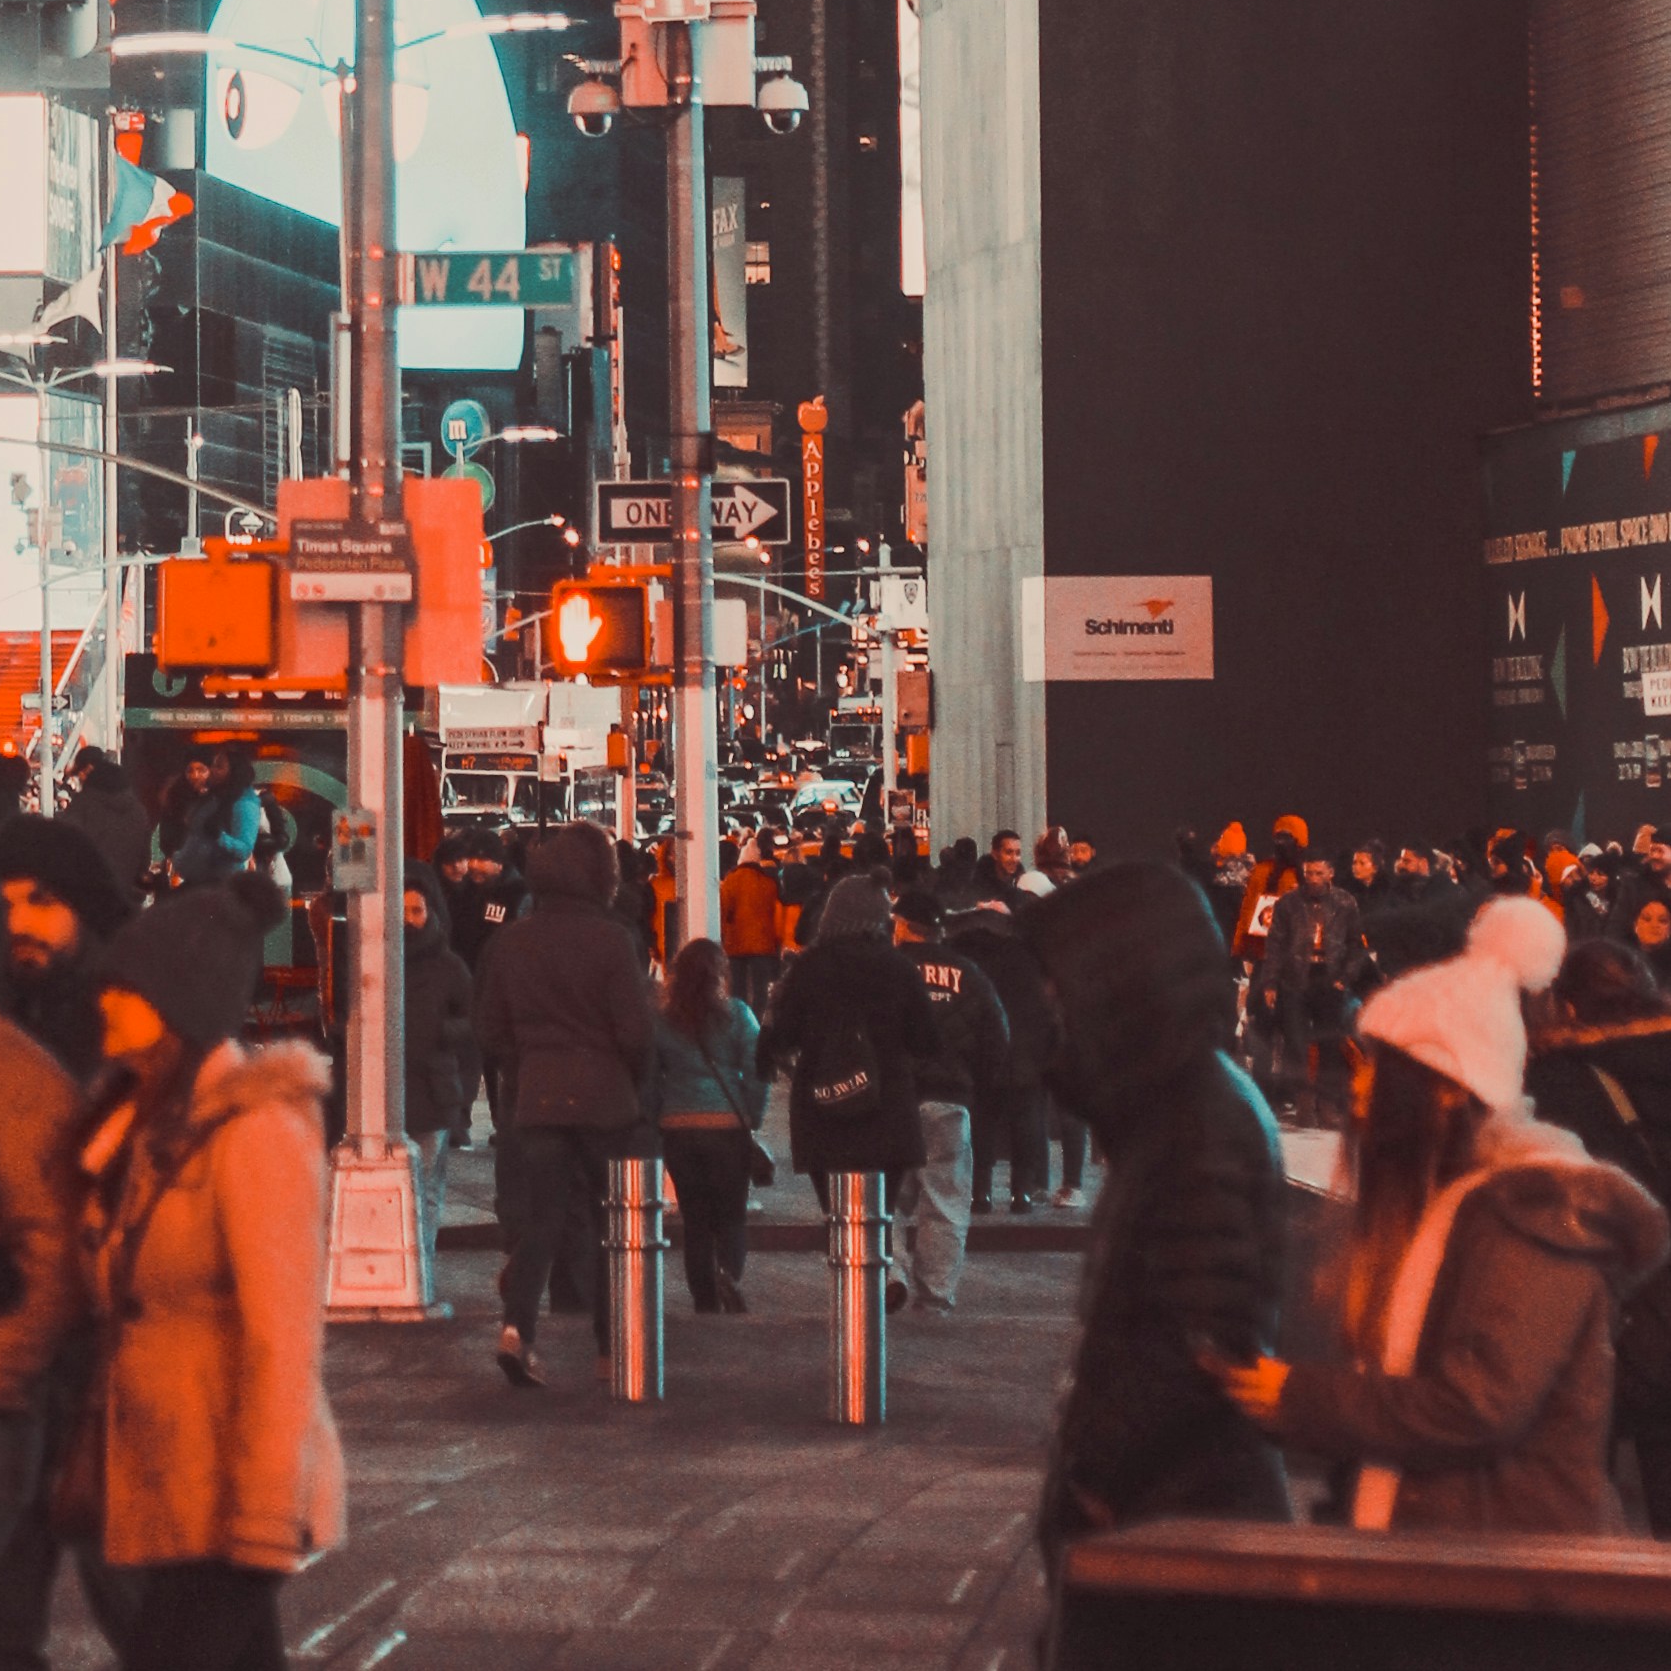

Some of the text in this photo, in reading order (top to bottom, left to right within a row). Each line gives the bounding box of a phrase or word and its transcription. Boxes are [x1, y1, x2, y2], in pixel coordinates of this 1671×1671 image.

[418, 256, 562, 303] W 44 ST
[297, 538, 393, 555] Times Square
[1085, 618, 1175, 636] Schimenti
[925, 963, 962, 994] RNY
